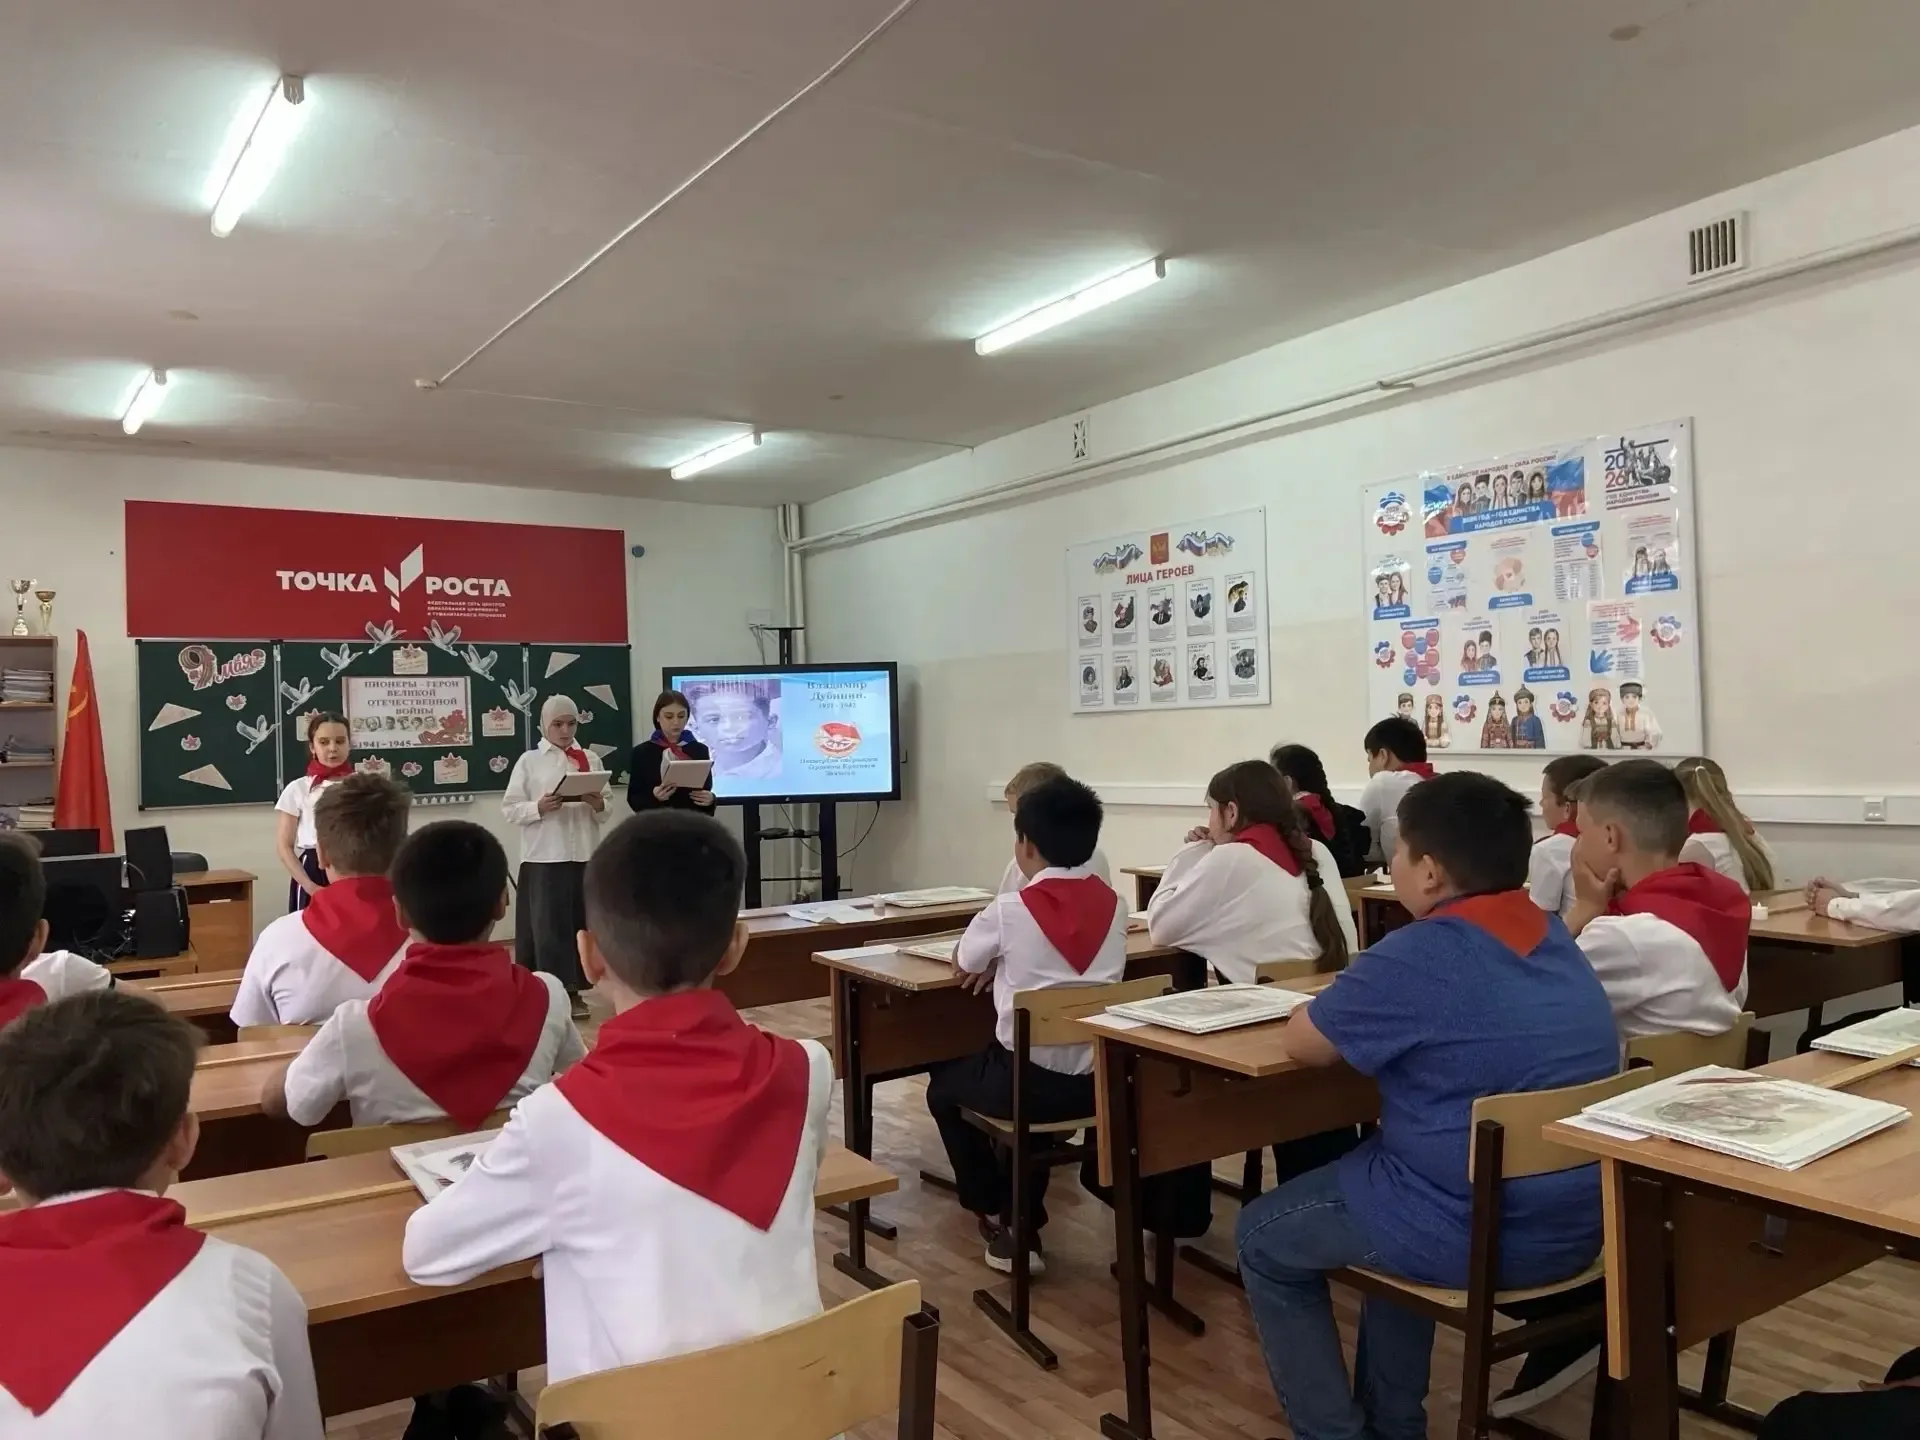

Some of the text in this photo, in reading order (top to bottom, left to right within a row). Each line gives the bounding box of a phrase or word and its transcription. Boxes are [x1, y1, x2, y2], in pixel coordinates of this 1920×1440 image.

[1604, 452, 1627, 471] 20
[1605, 471, 1626, 488] 26
[1126, 564, 1194, 584] ЛИЦА ГЕРОЕВ
[276, 570, 512, 597] ТОЧКА РОСТА
[179, 645, 216, 690] 9
[807, 681, 867, 690] Владимир
[387, 689, 436, 697] ВЕЛИКОЙ
[367, 698, 457, 706] ОТЕЧЕСТВЕННОЙ
[395, 707, 434, 715] ВОЙНЫ
[359, 740, 380, 748] 1941
[389, 740, 412, 748] 1945
